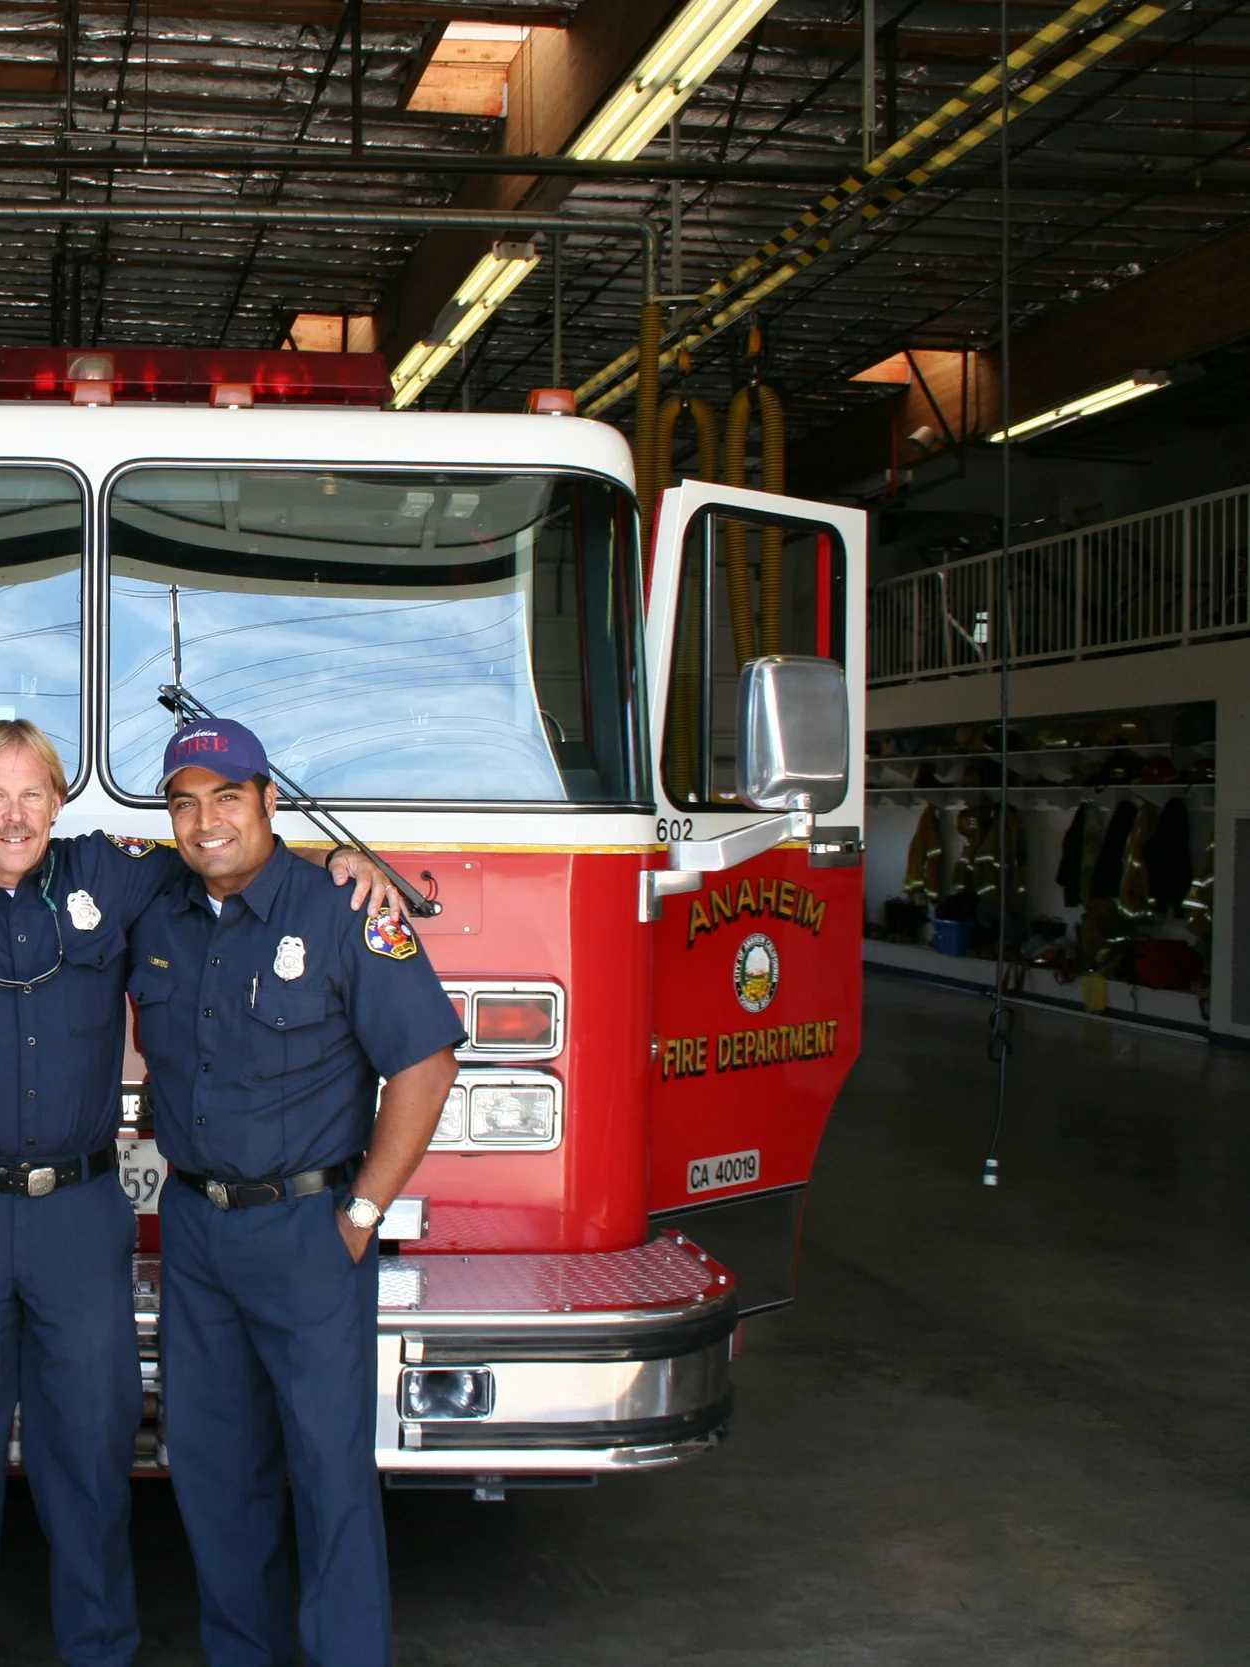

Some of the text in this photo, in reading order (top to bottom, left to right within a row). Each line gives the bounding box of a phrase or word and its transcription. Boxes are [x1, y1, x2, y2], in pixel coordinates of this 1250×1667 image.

[174, 737, 230, 761] FIRE
[688, 876, 827, 947] ANAHEIM
[662, 1020, 838, 1080] FIRE DEPARTMENT
[690, 1155, 757, 1190] CA 40019
